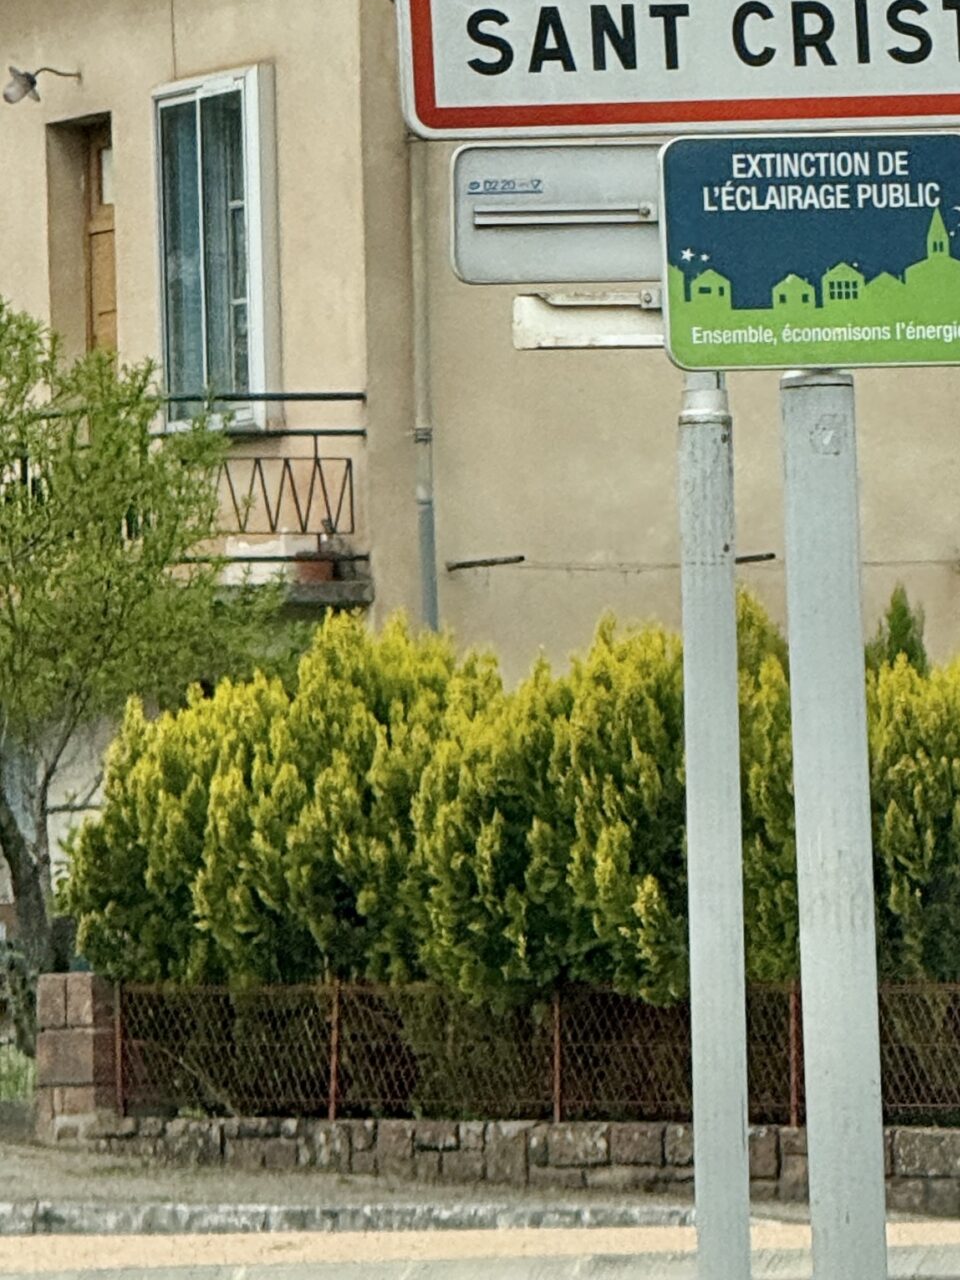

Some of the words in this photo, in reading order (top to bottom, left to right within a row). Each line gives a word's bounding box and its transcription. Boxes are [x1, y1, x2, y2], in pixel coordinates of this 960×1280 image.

[466, 3, 690, 76] SANT
[732, 152, 870, 179] EXTINCTION
[877, 151, 909, 176] DE
[857, 182, 940, 208] PUBLIC
[691, 325, 778, 345] Ensemble,
[781, 323, 891, 343] économisons
